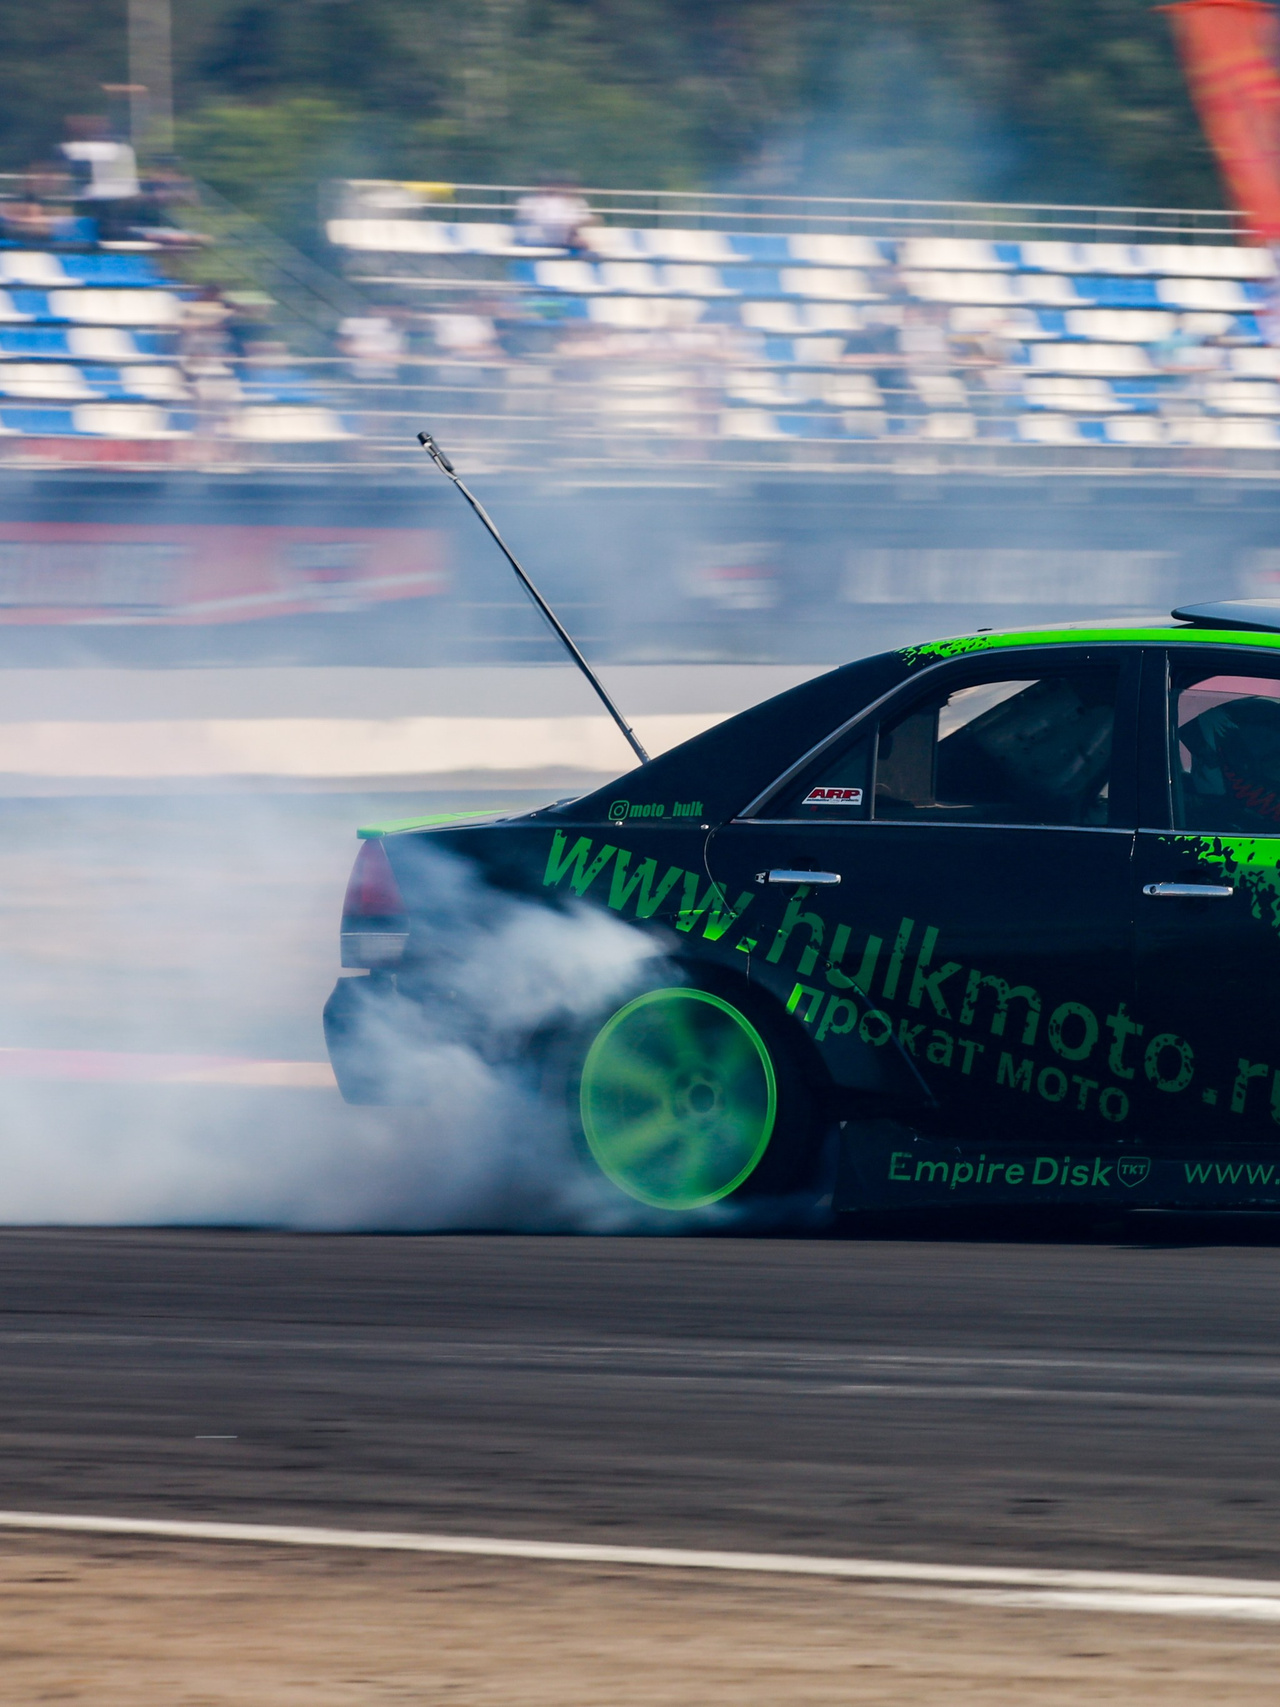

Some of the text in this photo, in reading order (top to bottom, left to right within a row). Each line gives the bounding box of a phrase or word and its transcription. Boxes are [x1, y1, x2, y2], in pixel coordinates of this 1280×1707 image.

[808, 789, 860, 799] ARP
[628, 801, 703, 819] moto_hulk
[888, 1152, 1111, 1190] Empire Disk
